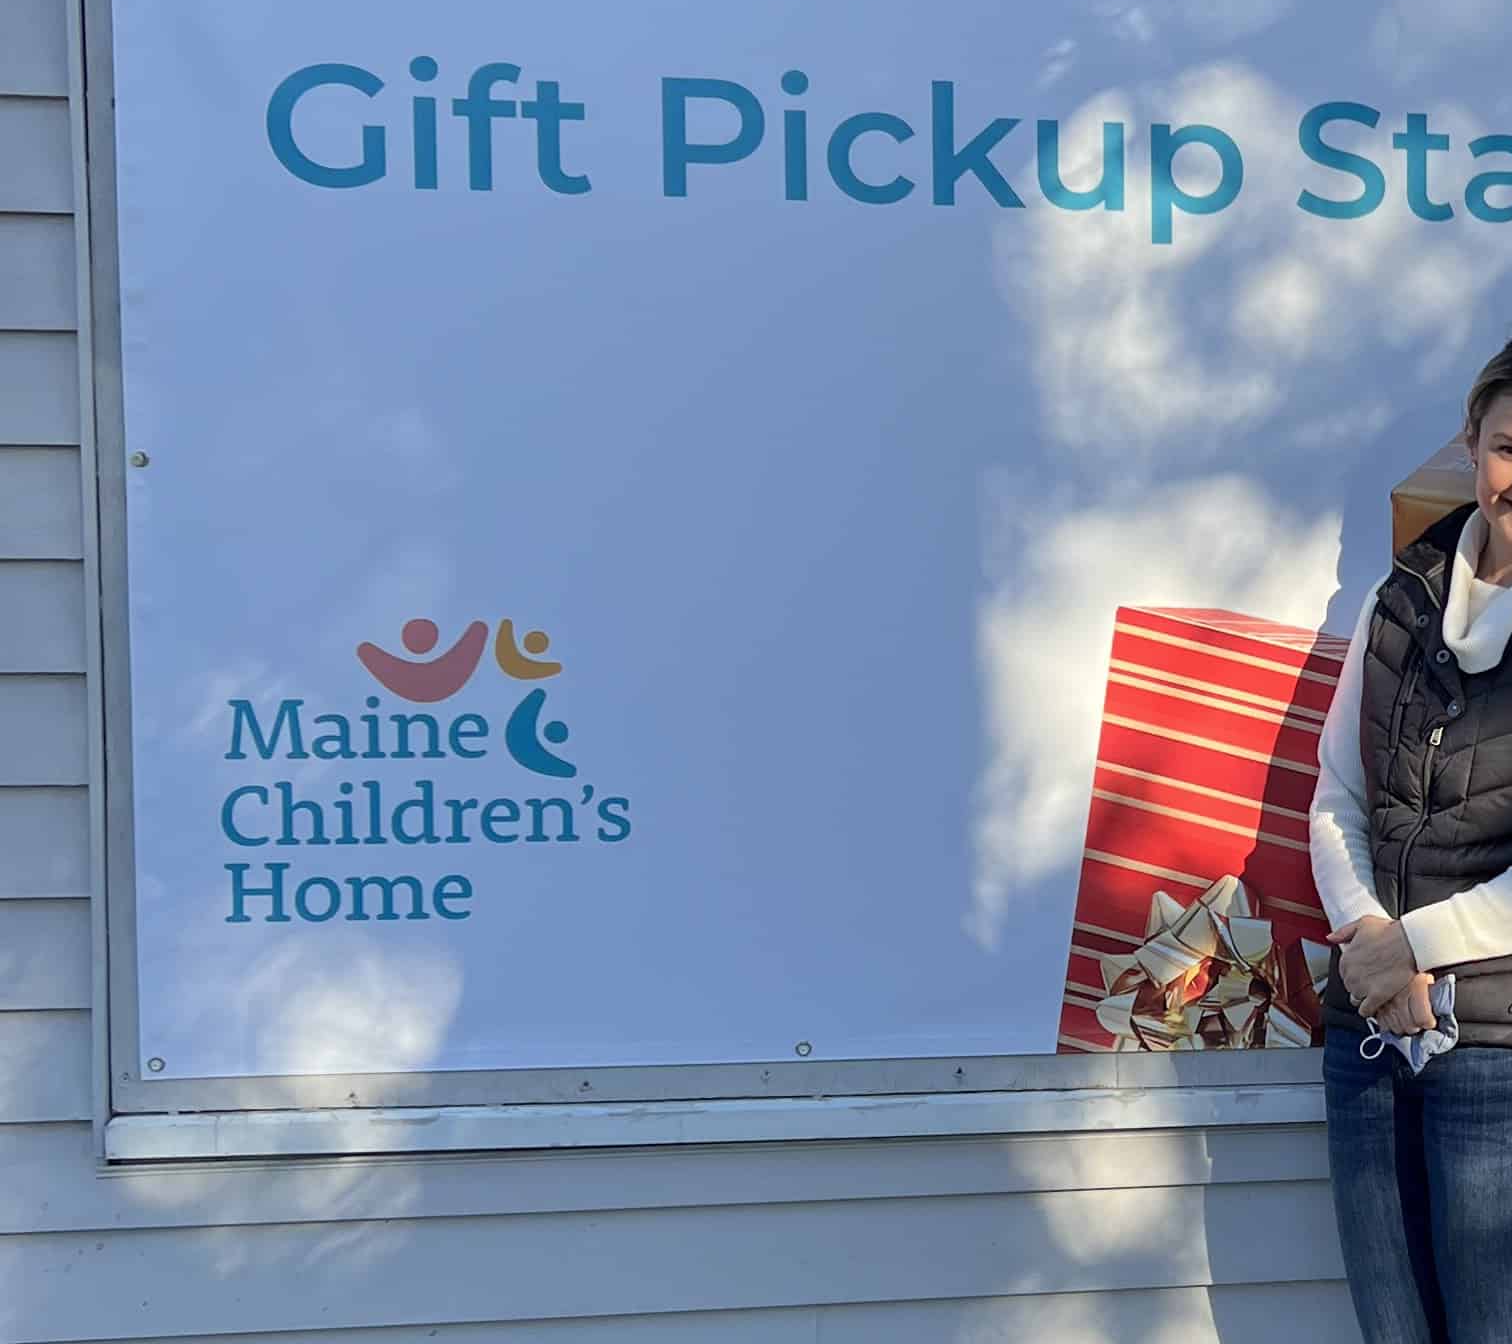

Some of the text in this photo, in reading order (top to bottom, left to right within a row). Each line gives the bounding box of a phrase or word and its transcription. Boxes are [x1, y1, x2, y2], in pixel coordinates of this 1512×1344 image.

[266, 55, 592, 195] Gift
[660, 69, 1245, 245] Pickup
[224, 696, 489, 760] Maine
[221, 780, 632, 847] Children’s
[224, 862, 473, 923] Home
